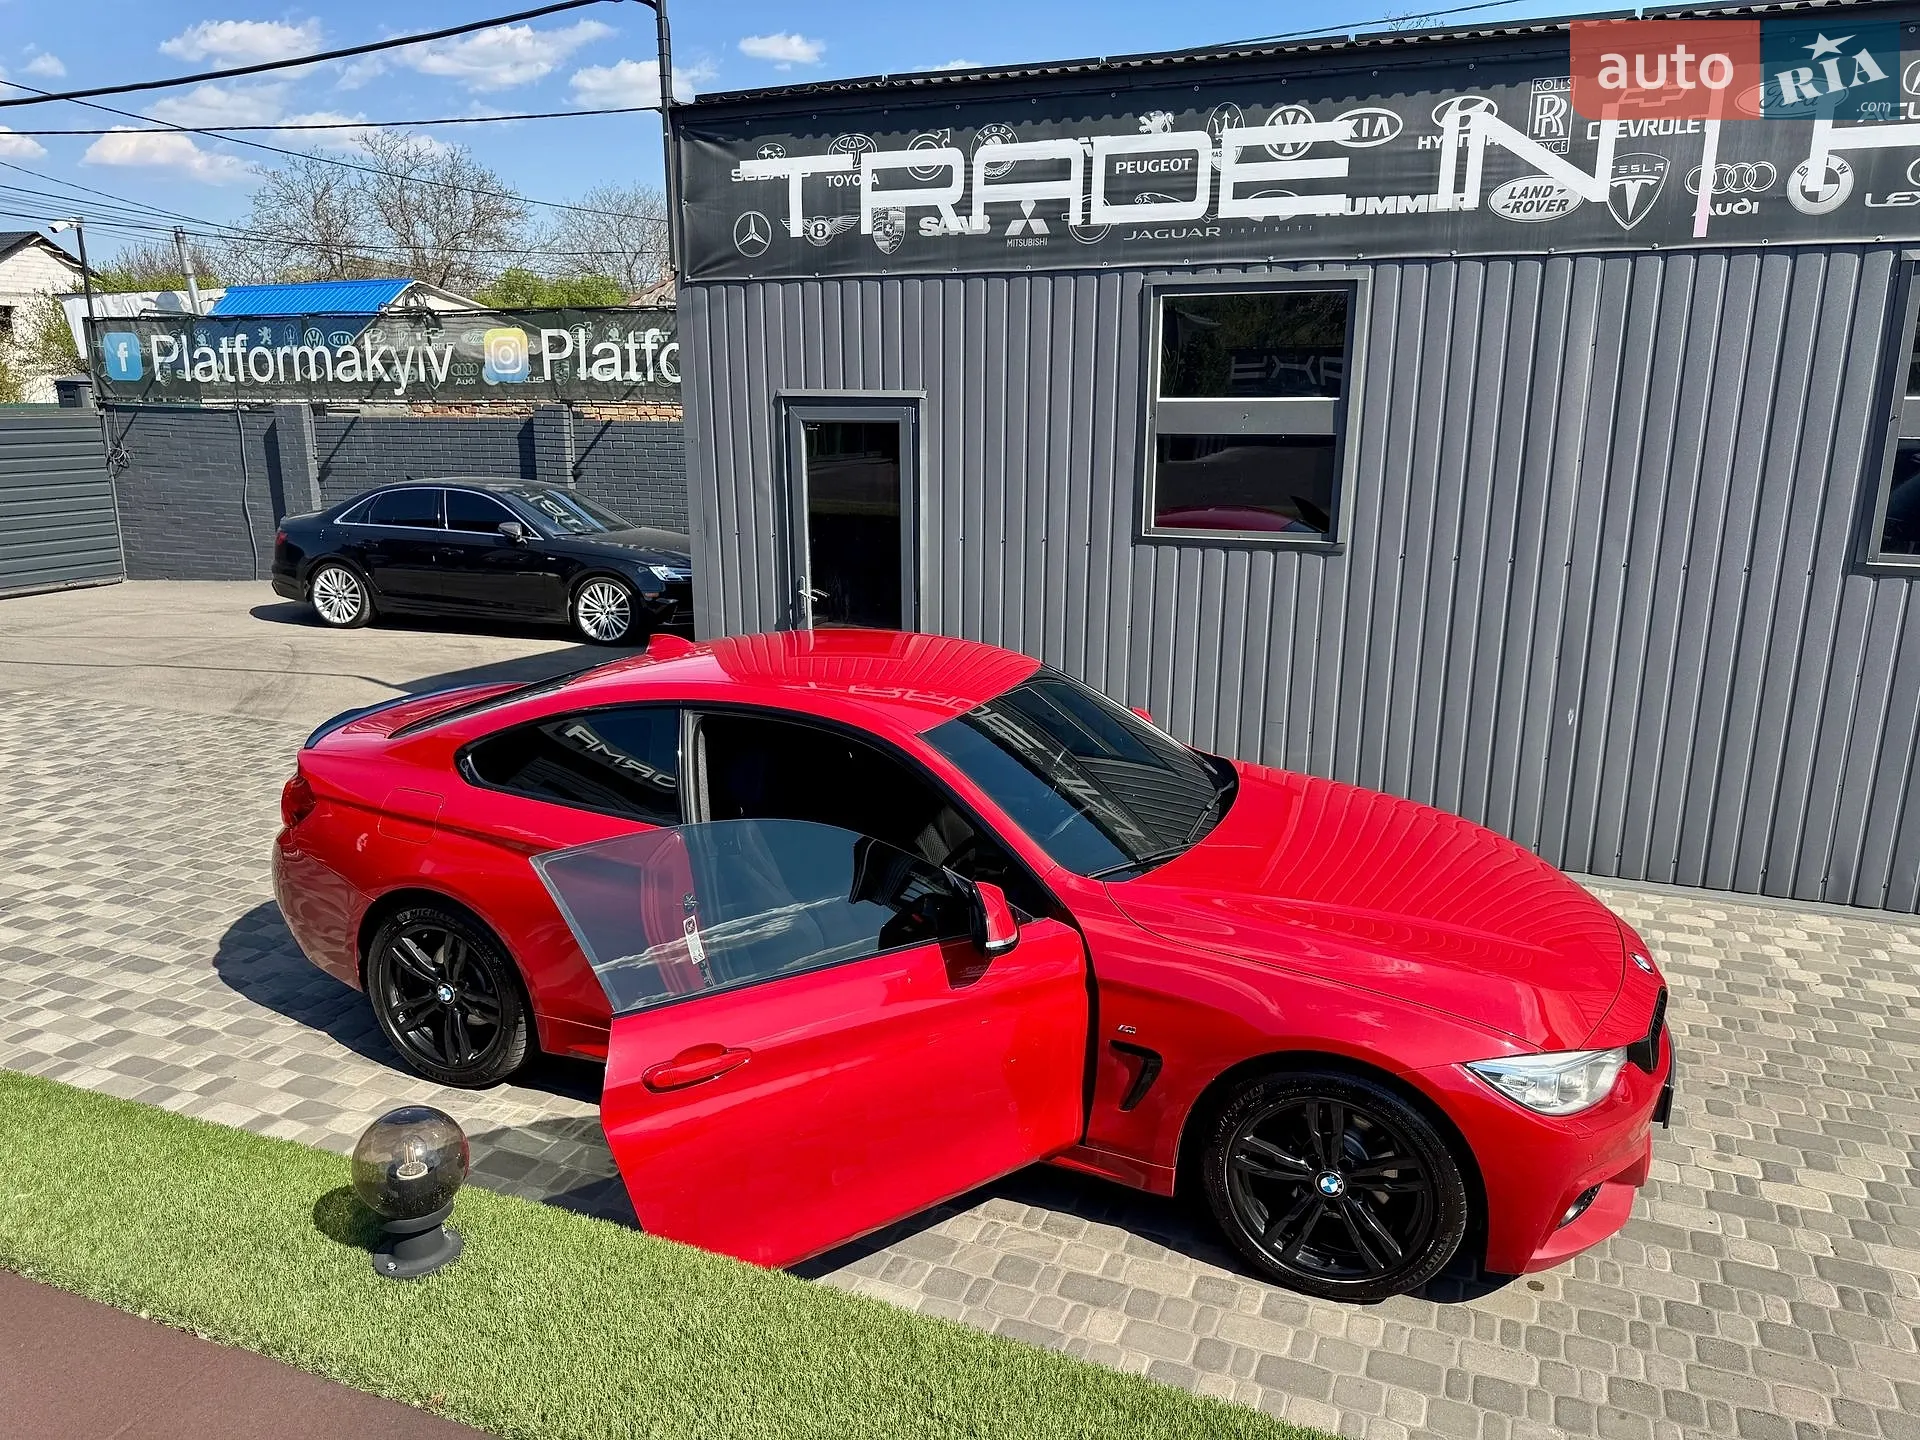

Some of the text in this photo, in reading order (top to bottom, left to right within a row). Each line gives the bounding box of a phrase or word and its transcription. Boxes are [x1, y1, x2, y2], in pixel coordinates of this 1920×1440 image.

[1586, 113, 1710, 140] CEVROLE
[1115, 157, 1193, 175] PEUGEOT
[1612, 162, 1665, 174] ESLA
[1797, 156, 1850, 178] BW
[740, 120, 1350, 238] TRADE
[825, 172, 880, 188] TOYOA
[1508, 185, 1554, 200] LAND
[1510, 199, 1570, 214] ROVER
[1123, 226, 1221, 241] JAGUAR
[1006, 237, 1049, 248] MITSUBISHI
[150, 333, 454, 396] Platformakyiv
